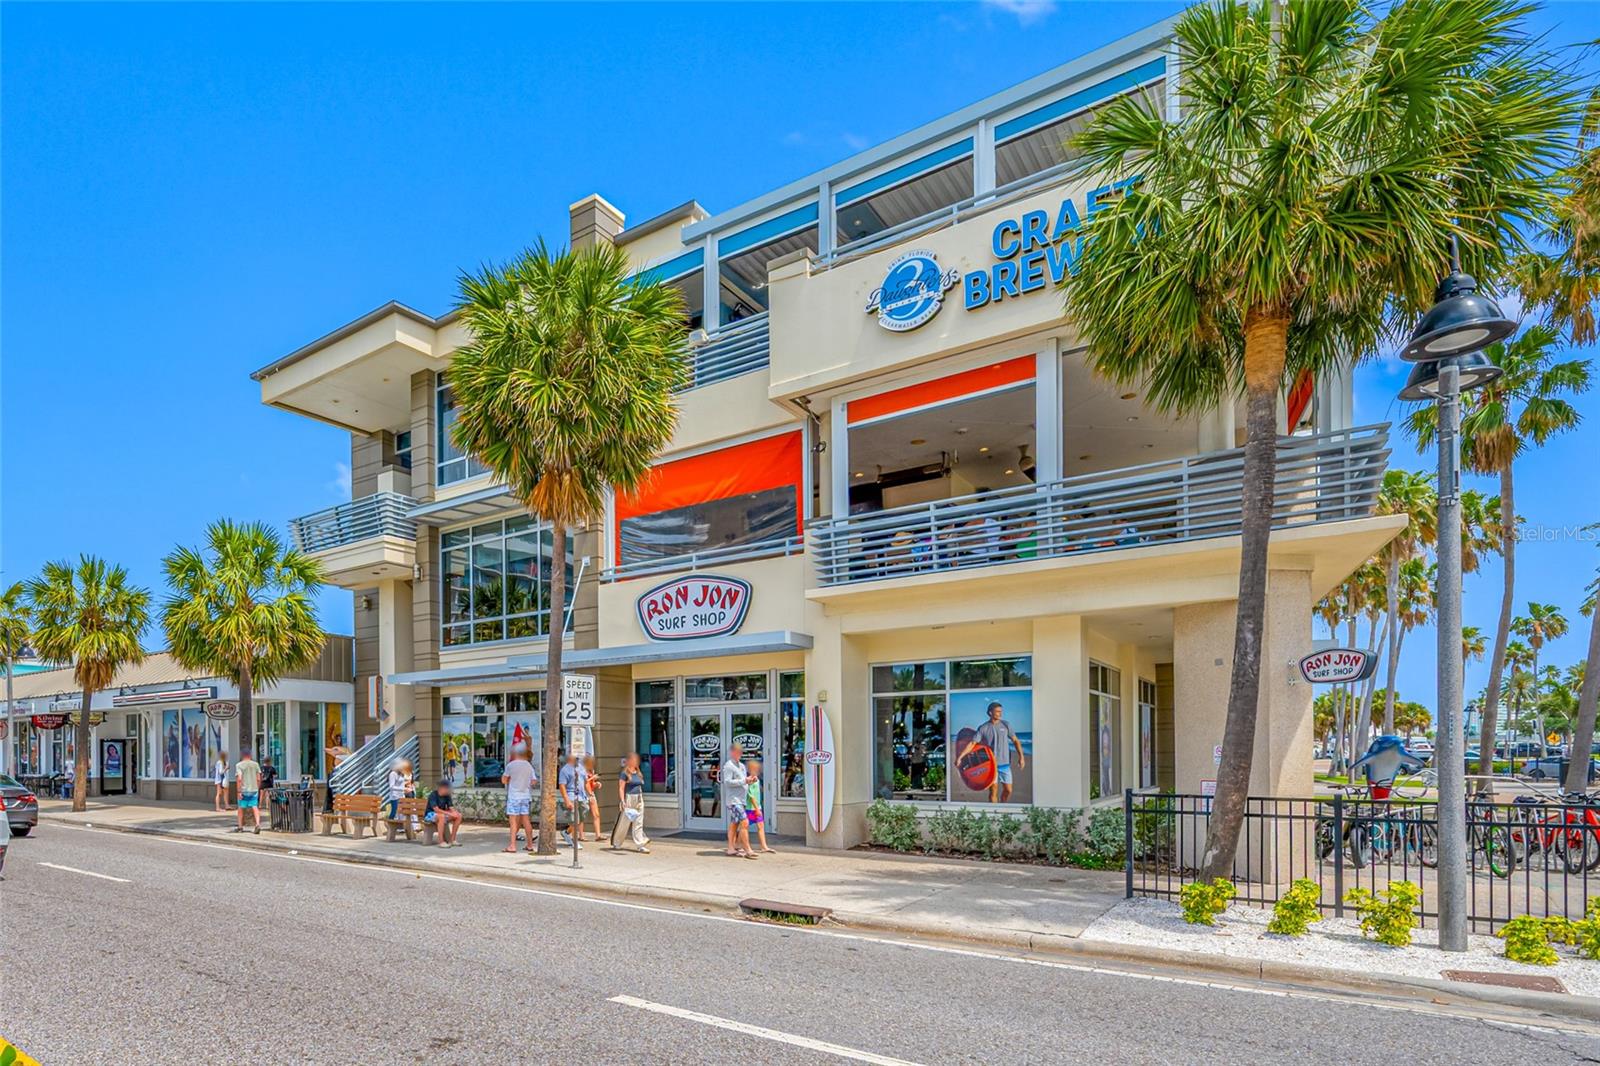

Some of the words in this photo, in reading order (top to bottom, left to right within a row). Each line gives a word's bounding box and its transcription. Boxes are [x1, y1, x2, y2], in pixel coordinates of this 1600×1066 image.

[647, 585, 689, 622] RON
[693, 584, 740, 610] JON
[658, 615, 687, 631] SURF
[692, 611, 726, 627] SHOP
[1306, 654, 1331, 672] RON
[1334, 654, 1361, 666] JON
[1333, 667, 1354, 676] SHOP
[566, 680, 592, 690] SPEED
[568, 691, 589, 700] LIMIT
[565, 701, 592, 720] 25
